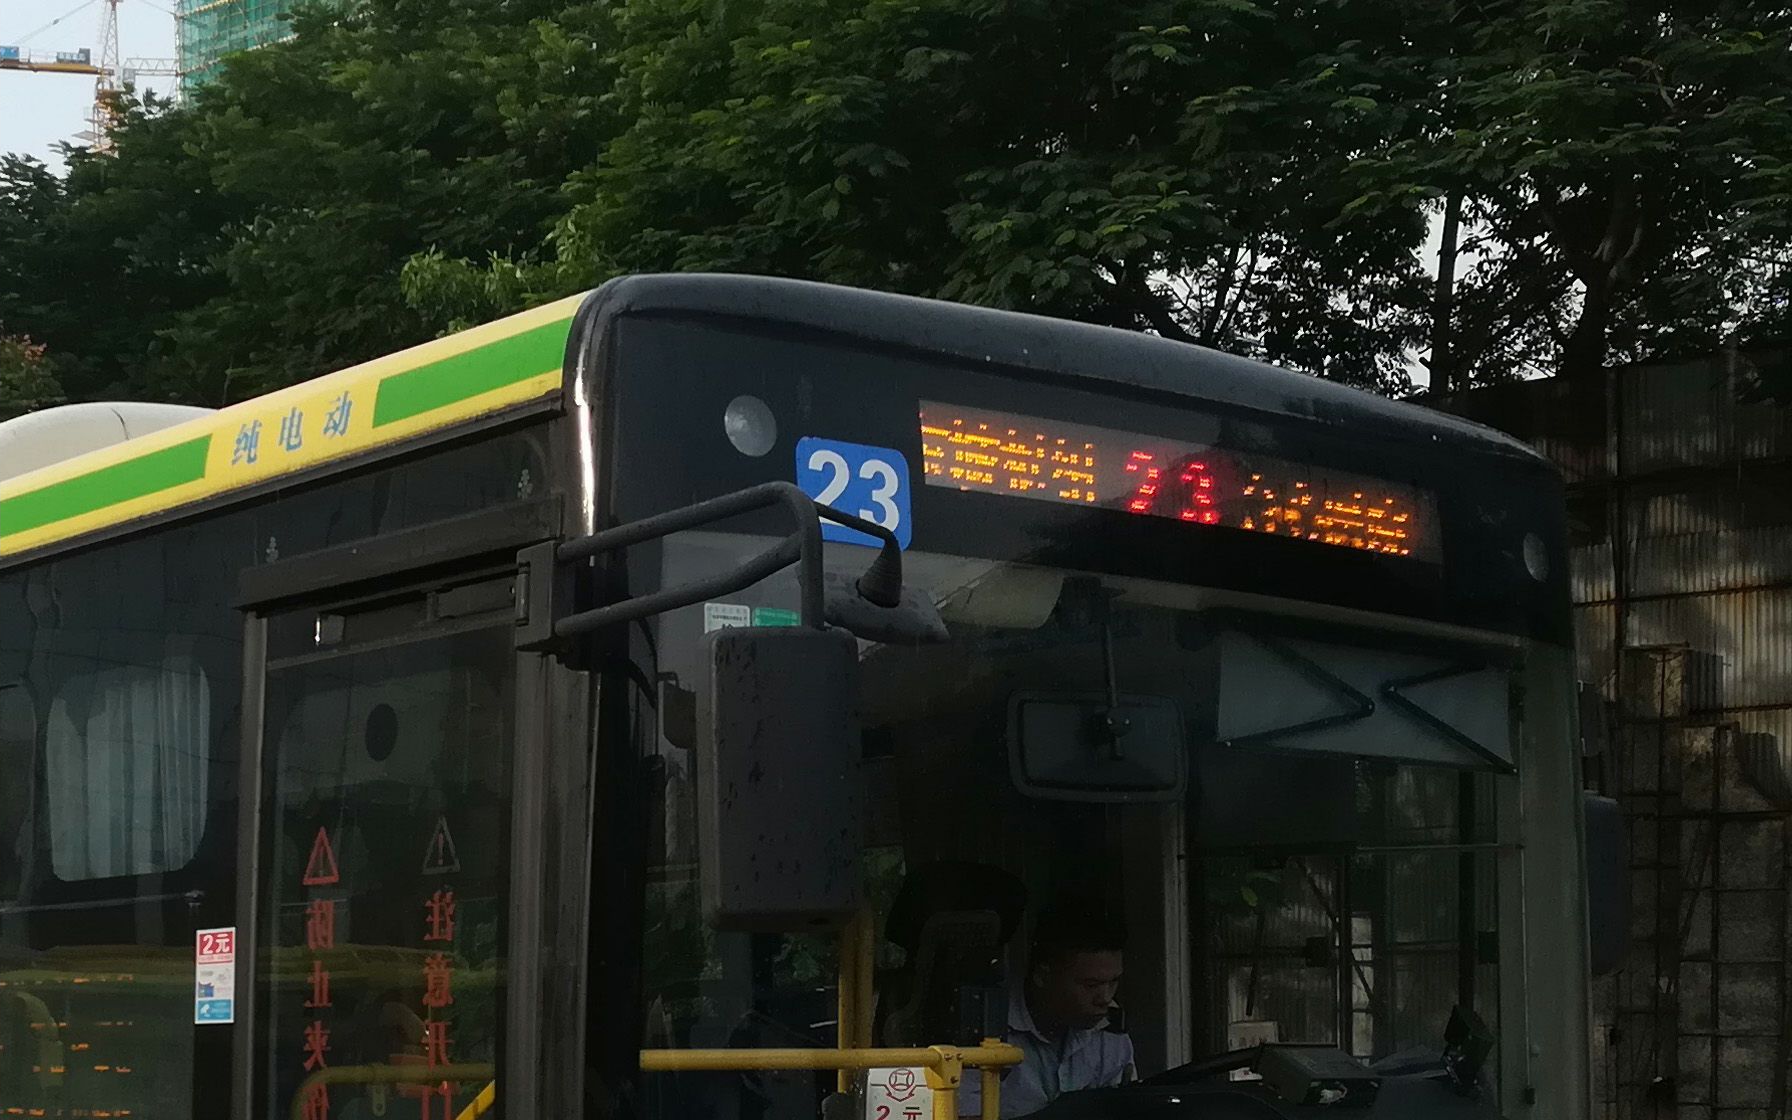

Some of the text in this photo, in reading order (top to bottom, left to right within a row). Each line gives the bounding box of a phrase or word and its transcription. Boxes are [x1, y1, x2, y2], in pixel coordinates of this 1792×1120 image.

[231, 391, 352, 465] 纯电动
[809, 450, 899, 533] 23
[203, 933, 230, 955] 2元
